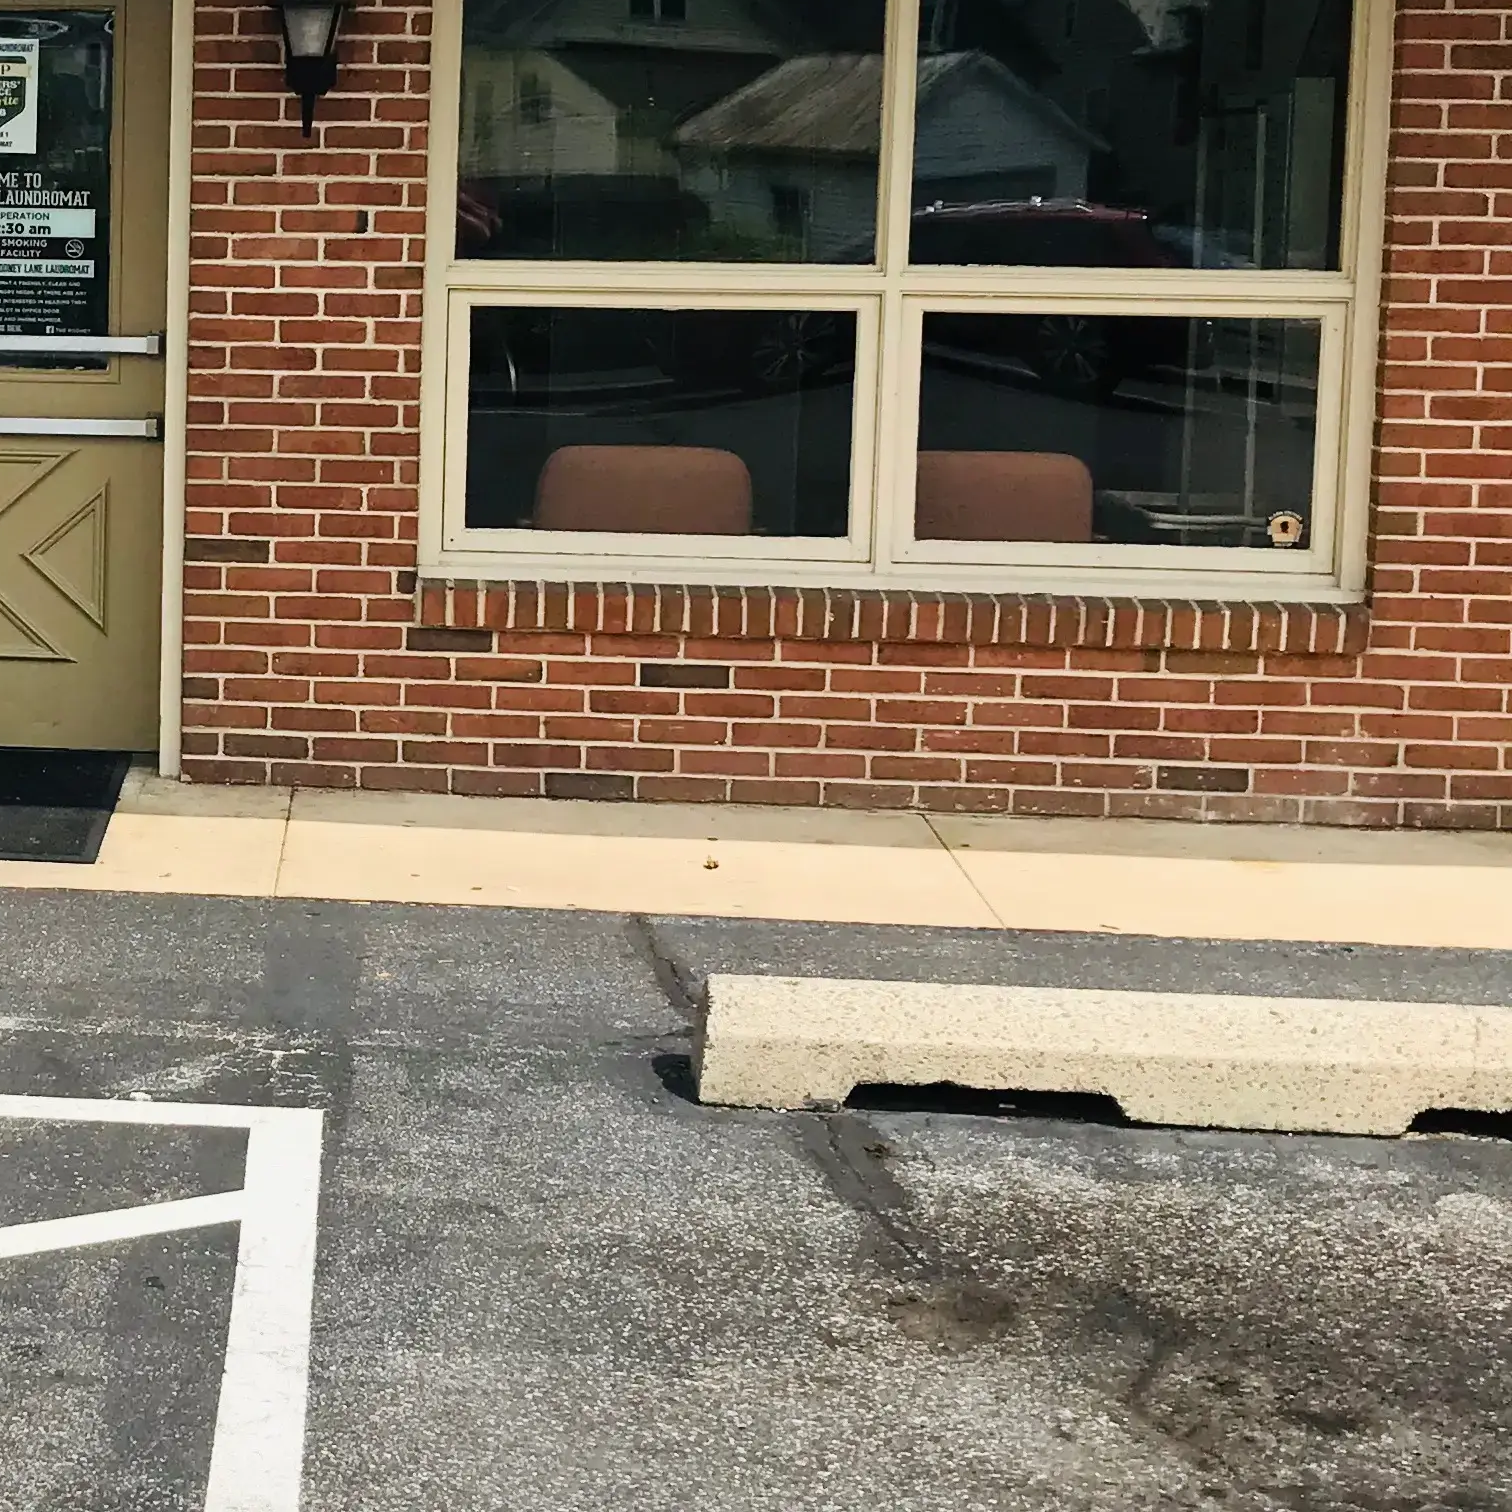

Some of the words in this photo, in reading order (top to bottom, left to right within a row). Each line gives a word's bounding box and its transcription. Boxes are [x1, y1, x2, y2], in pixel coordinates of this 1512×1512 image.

[24, 173, 42, 189] TO
[28, 225, 51, 235] am
[1, 238, 48, 248] SMOKING
[0, 249, 42, 258] FACILITY
